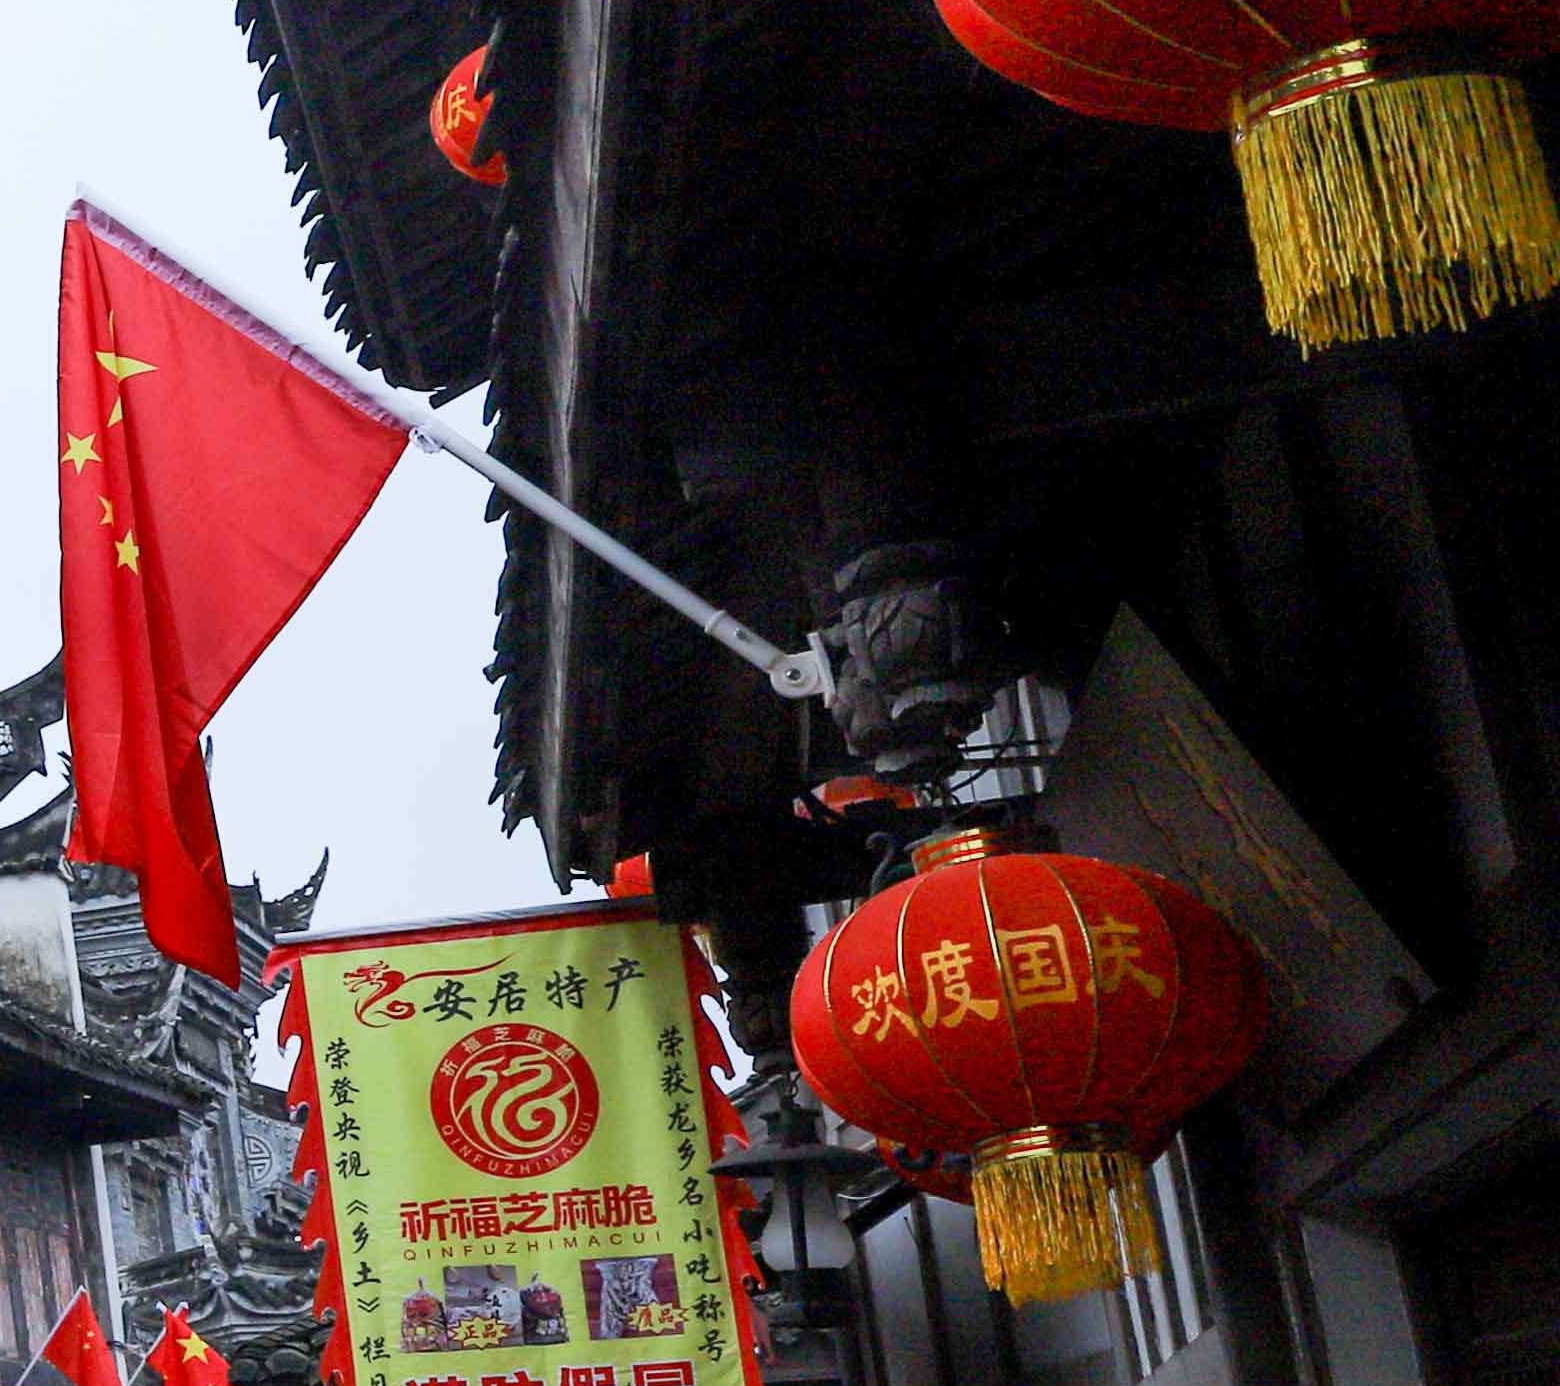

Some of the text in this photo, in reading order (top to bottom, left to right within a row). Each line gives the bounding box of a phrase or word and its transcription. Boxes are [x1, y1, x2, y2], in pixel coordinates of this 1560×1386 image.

[436, 82, 477, 141] 庆
[423, 958, 646, 1022] 安居特产
[850, 915, 1166, 1043] 欢度国庆
[400, 1184, 658, 1243] 祈福芝麻脆
[403, 1231, 661, 1261] QINFUZHIMACUI
